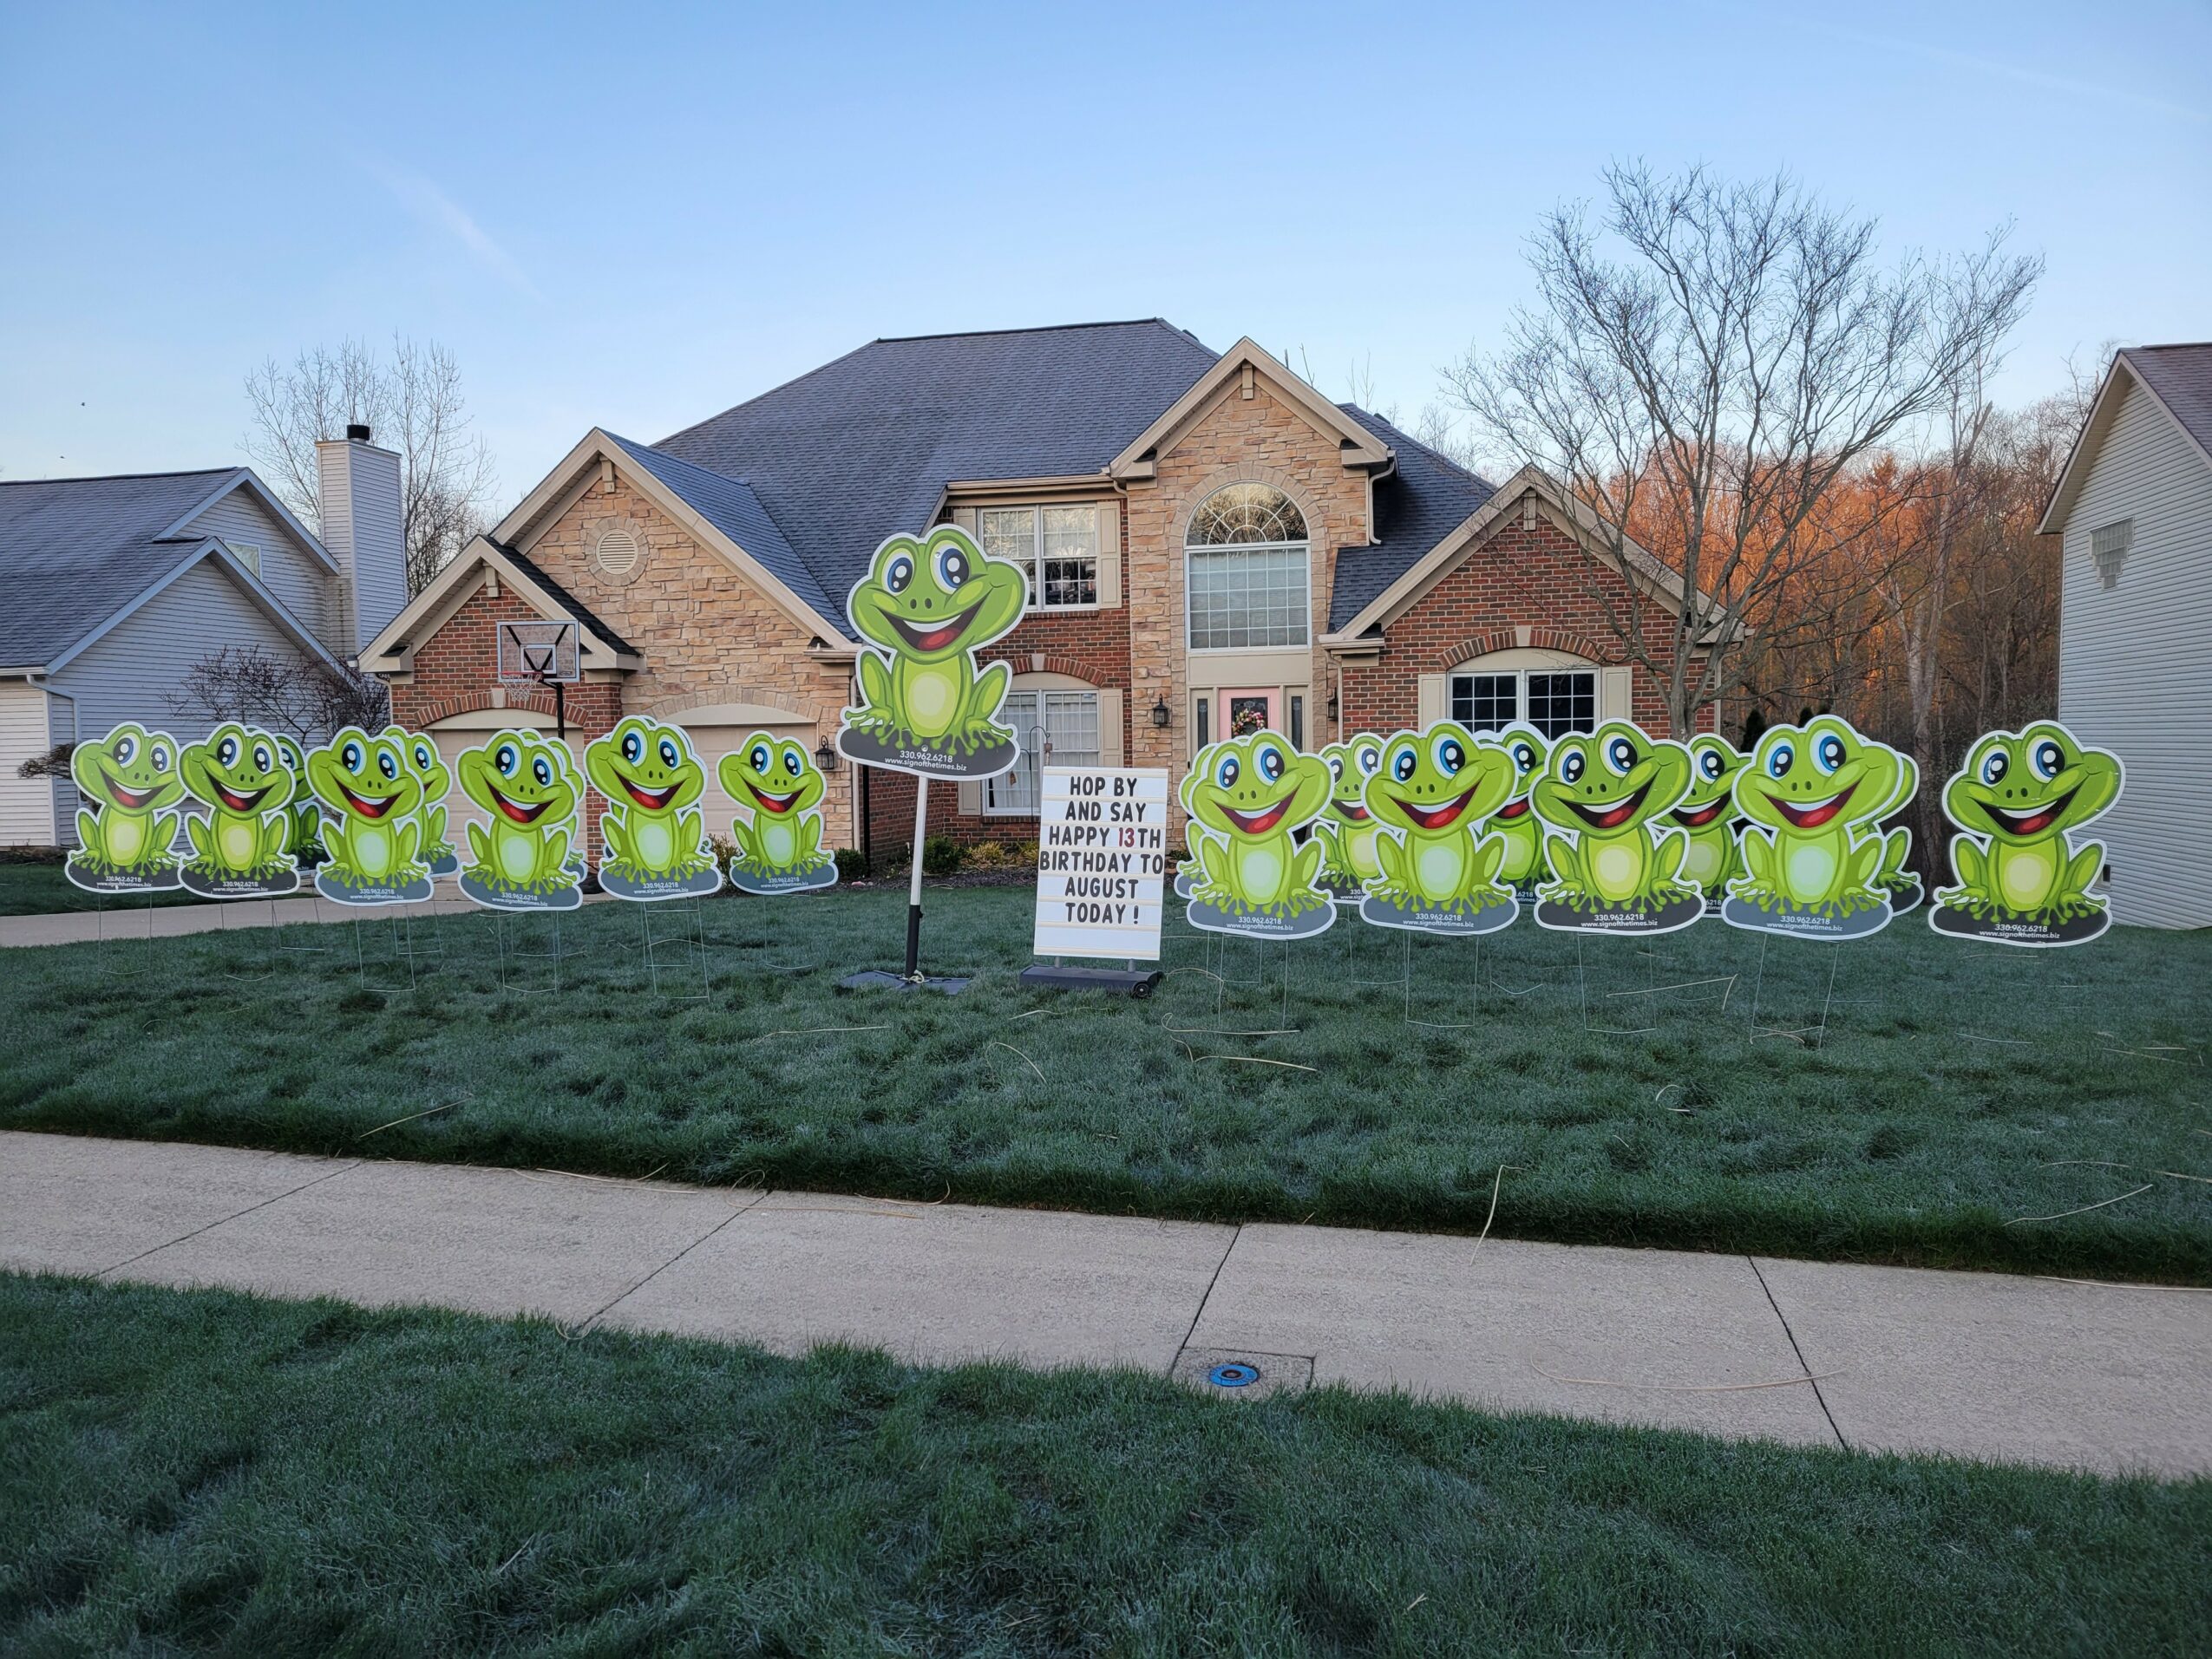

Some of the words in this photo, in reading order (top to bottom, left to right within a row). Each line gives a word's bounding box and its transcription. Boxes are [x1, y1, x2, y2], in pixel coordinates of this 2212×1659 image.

[900, 750, 953, 763] 330.962.6218
[885, 757, 967, 771] www.signofthetimes.biz
[1070, 775, 1106, 796] HOP
[1113, 777, 1138, 797] BY
[1065, 800, 1102, 821] AND
[1110, 801, 1147, 823] SAY
[1049, 825, 1109, 847] HAPPY
[1118, 827, 1161, 849] 13TH
[1039, 850, 1132, 872] BIRTHDAY
[1140, 853, 1163, 875] TO
[1064, 877, 1139, 898] AUGUST
[1065, 902, 1126, 924] TODAY
[1415, 912, 1462, 921] 330.962.6218
[1594, 913, 1645, 922] 330.962.6218
[1780, 915, 1830, 924] 330.962.6218
[1238, 916, 1282, 924] 330.962.6218
[1580, 919, 1658, 928] www.signofthetimes.biz
[1994, 924, 2048, 932] 330.962.6218
